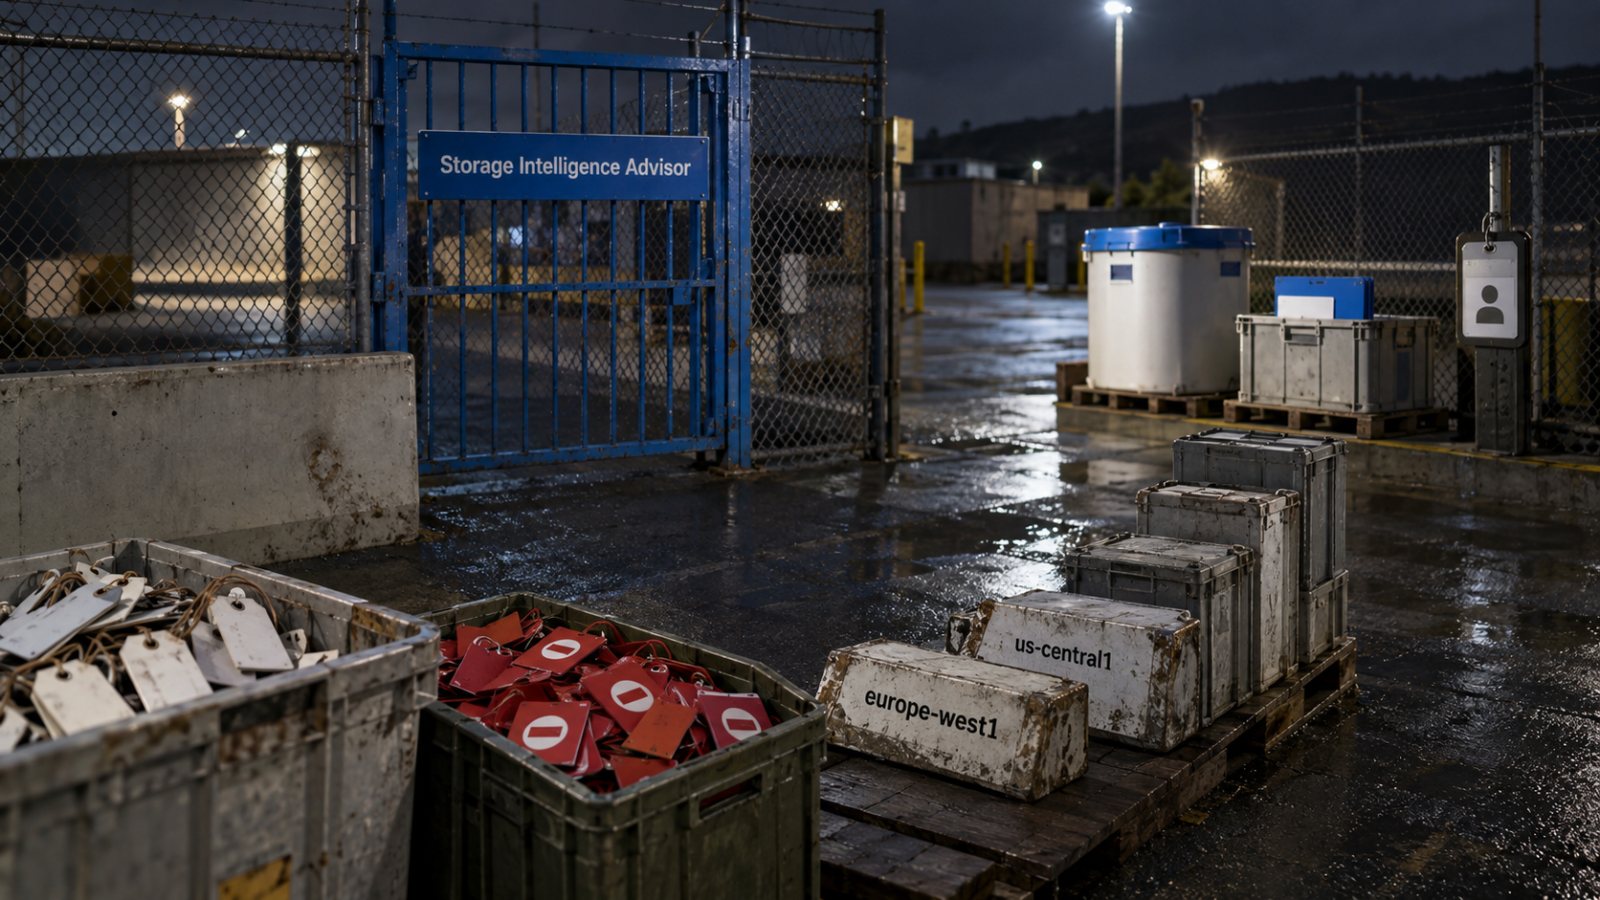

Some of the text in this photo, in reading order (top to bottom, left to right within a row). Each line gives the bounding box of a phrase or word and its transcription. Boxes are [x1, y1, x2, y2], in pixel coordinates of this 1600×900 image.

[440, 155, 691, 179] Storage Intelligence Advisor
[1015, 638, 1112, 670] us-central1
[865, 690, 998, 739] europe-west1
